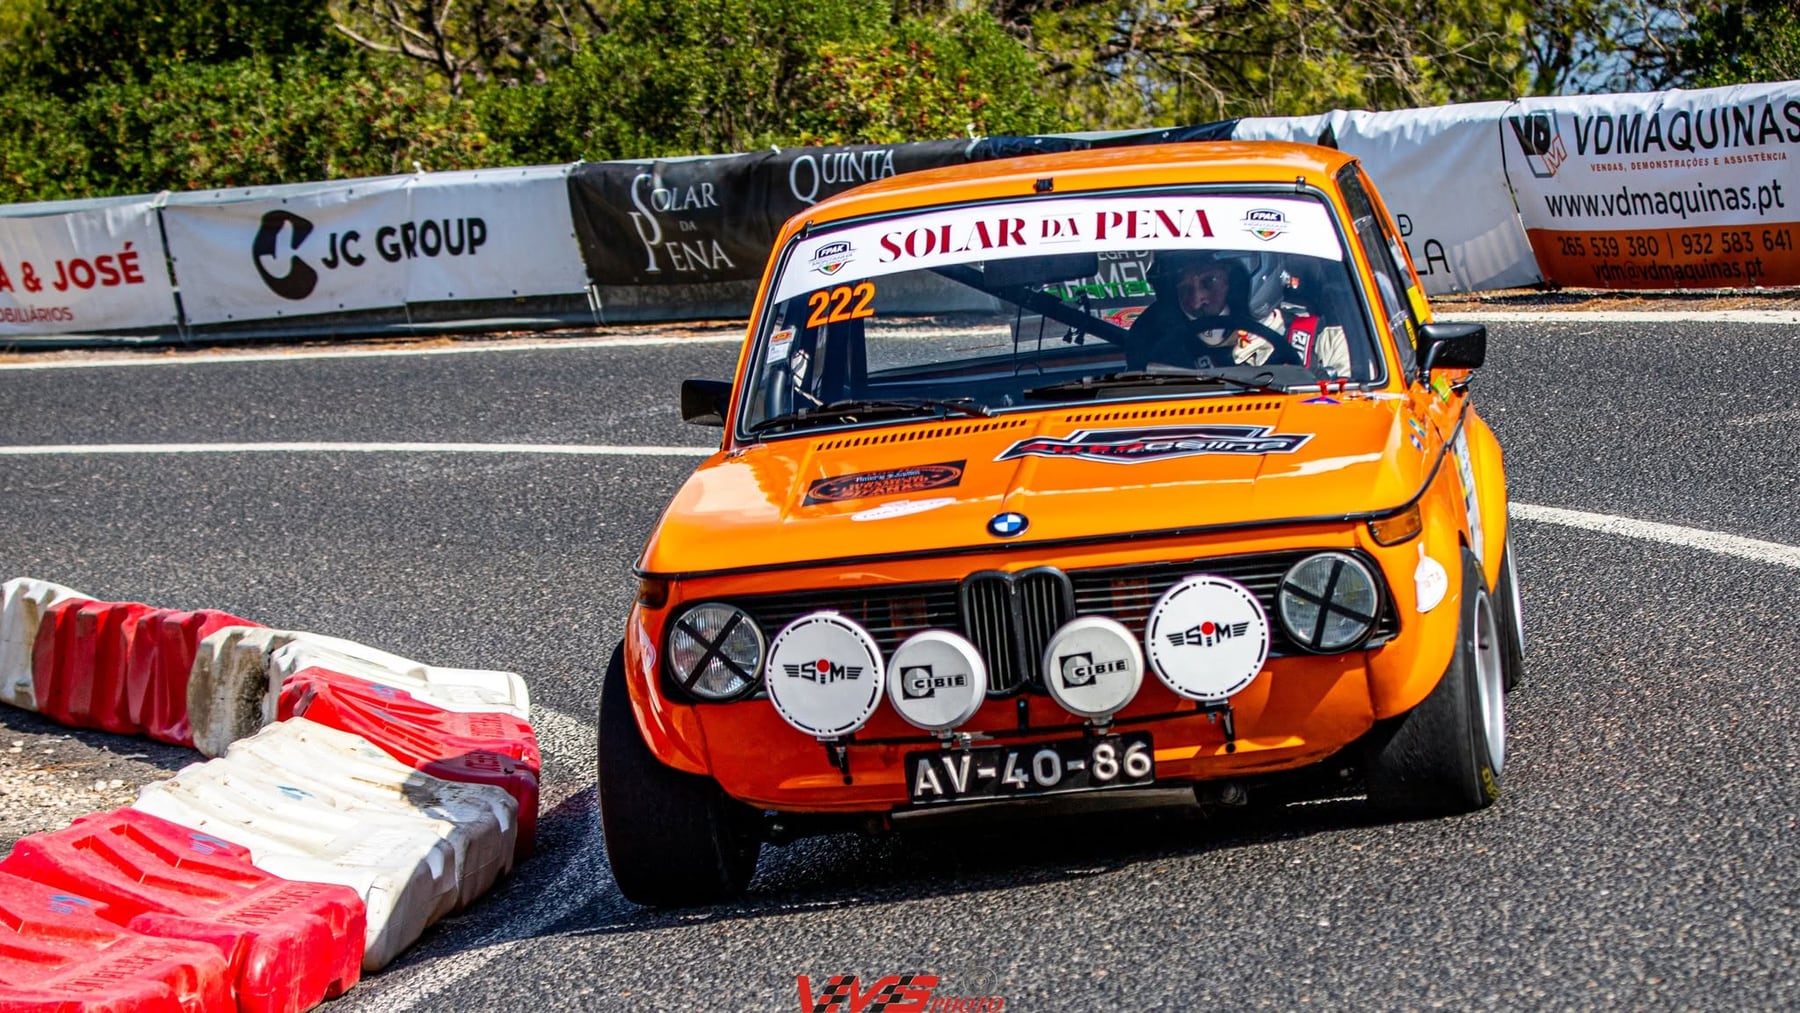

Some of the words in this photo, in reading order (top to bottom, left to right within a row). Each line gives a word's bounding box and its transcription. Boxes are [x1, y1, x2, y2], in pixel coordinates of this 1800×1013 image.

[789, 149, 896, 205] QUINTA
[1590, 162, 1627, 172] VENDAS,
[1631, 157, 1710, 171] DEMONSTRAÇÕES
[1714, 158, 1719, 166] E
[1724, 151, 1787, 165] ASSISTÊNCIA
[1544, 178, 1785, 220] www.vdmaquinas.pt
[322, 230, 366, 269] JC
[376, 217, 488, 262] GROUP
[680, 220, 697, 232] DA
[879, 217, 1027, 264] SOLAR
[1041, 217, 1080, 238] DA
[1095, 209, 1215, 240] PENA
[1557, 235, 1586, 257] 265
[1590, 235, 1620, 258] 539
[1625, 235, 1660, 257] 380
[1681, 232, 1713, 255] 932
[1721, 231, 1755, 254] 583
[1762, 228, 1793, 252] 641
[21, 261, 43, 293] &
[53, 241, 145, 292] JOSÉ
[1592, 257, 1766, 284] vdm@vdmaquinas.pt
[0, 305, 74, 323] BILIÁRIOS
[806, 281, 877, 330] 222
[914, 742, 1153, 797] AV-40-86
